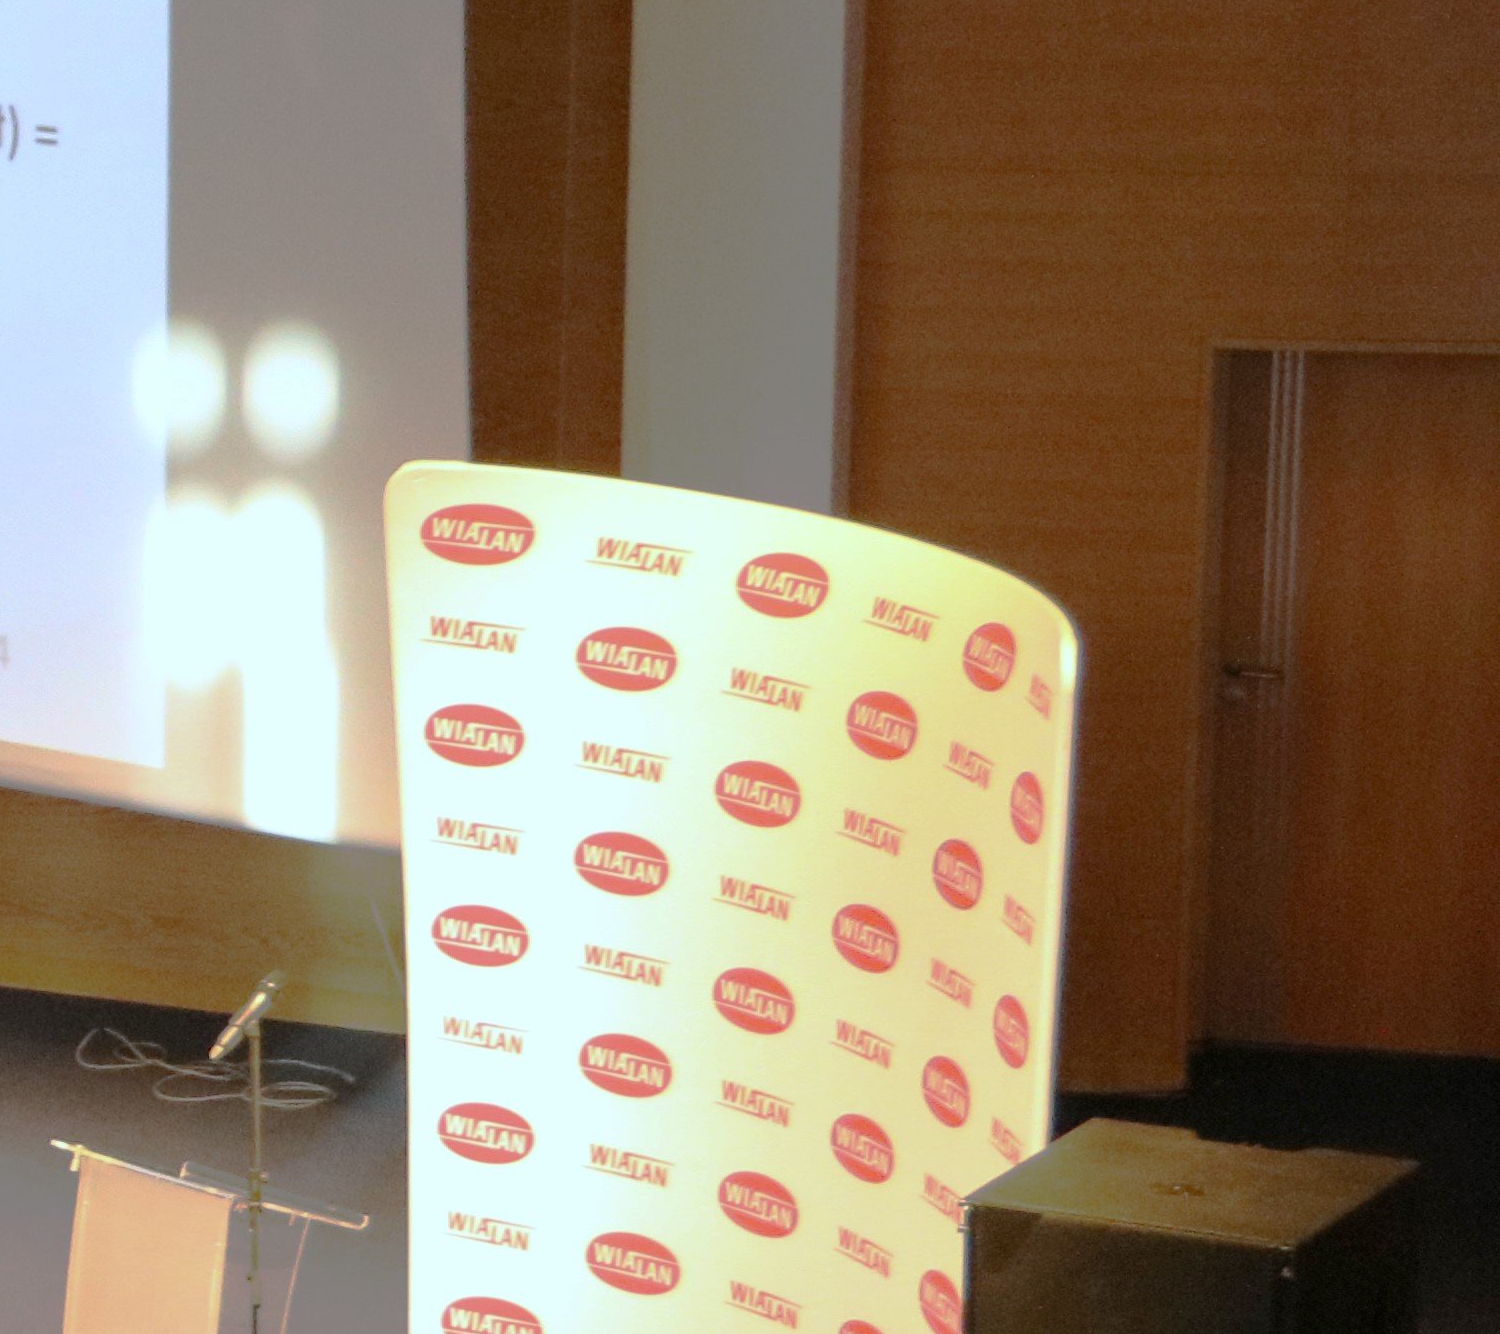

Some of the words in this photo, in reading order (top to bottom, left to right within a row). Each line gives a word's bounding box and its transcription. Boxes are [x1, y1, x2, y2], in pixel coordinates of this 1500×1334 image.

[431, 518, 524, 553] WIALAN
[746, 567, 820, 607] WIALAN
[584, 643, 669, 680] WIALAN
[432, 720, 516, 755] WIALAN
[722, 777, 794, 816] WIALAN
[583, 848, 662, 886] WIALAN
[439, 921, 522, 956] WIALAN
[719, 981, 789, 1024] WIALAN
[587, 1049, 665, 1086] WIALAN
[445, 1117, 526, 1154] WIALAN
[594, 1246, 673, 1286] WIALAN
